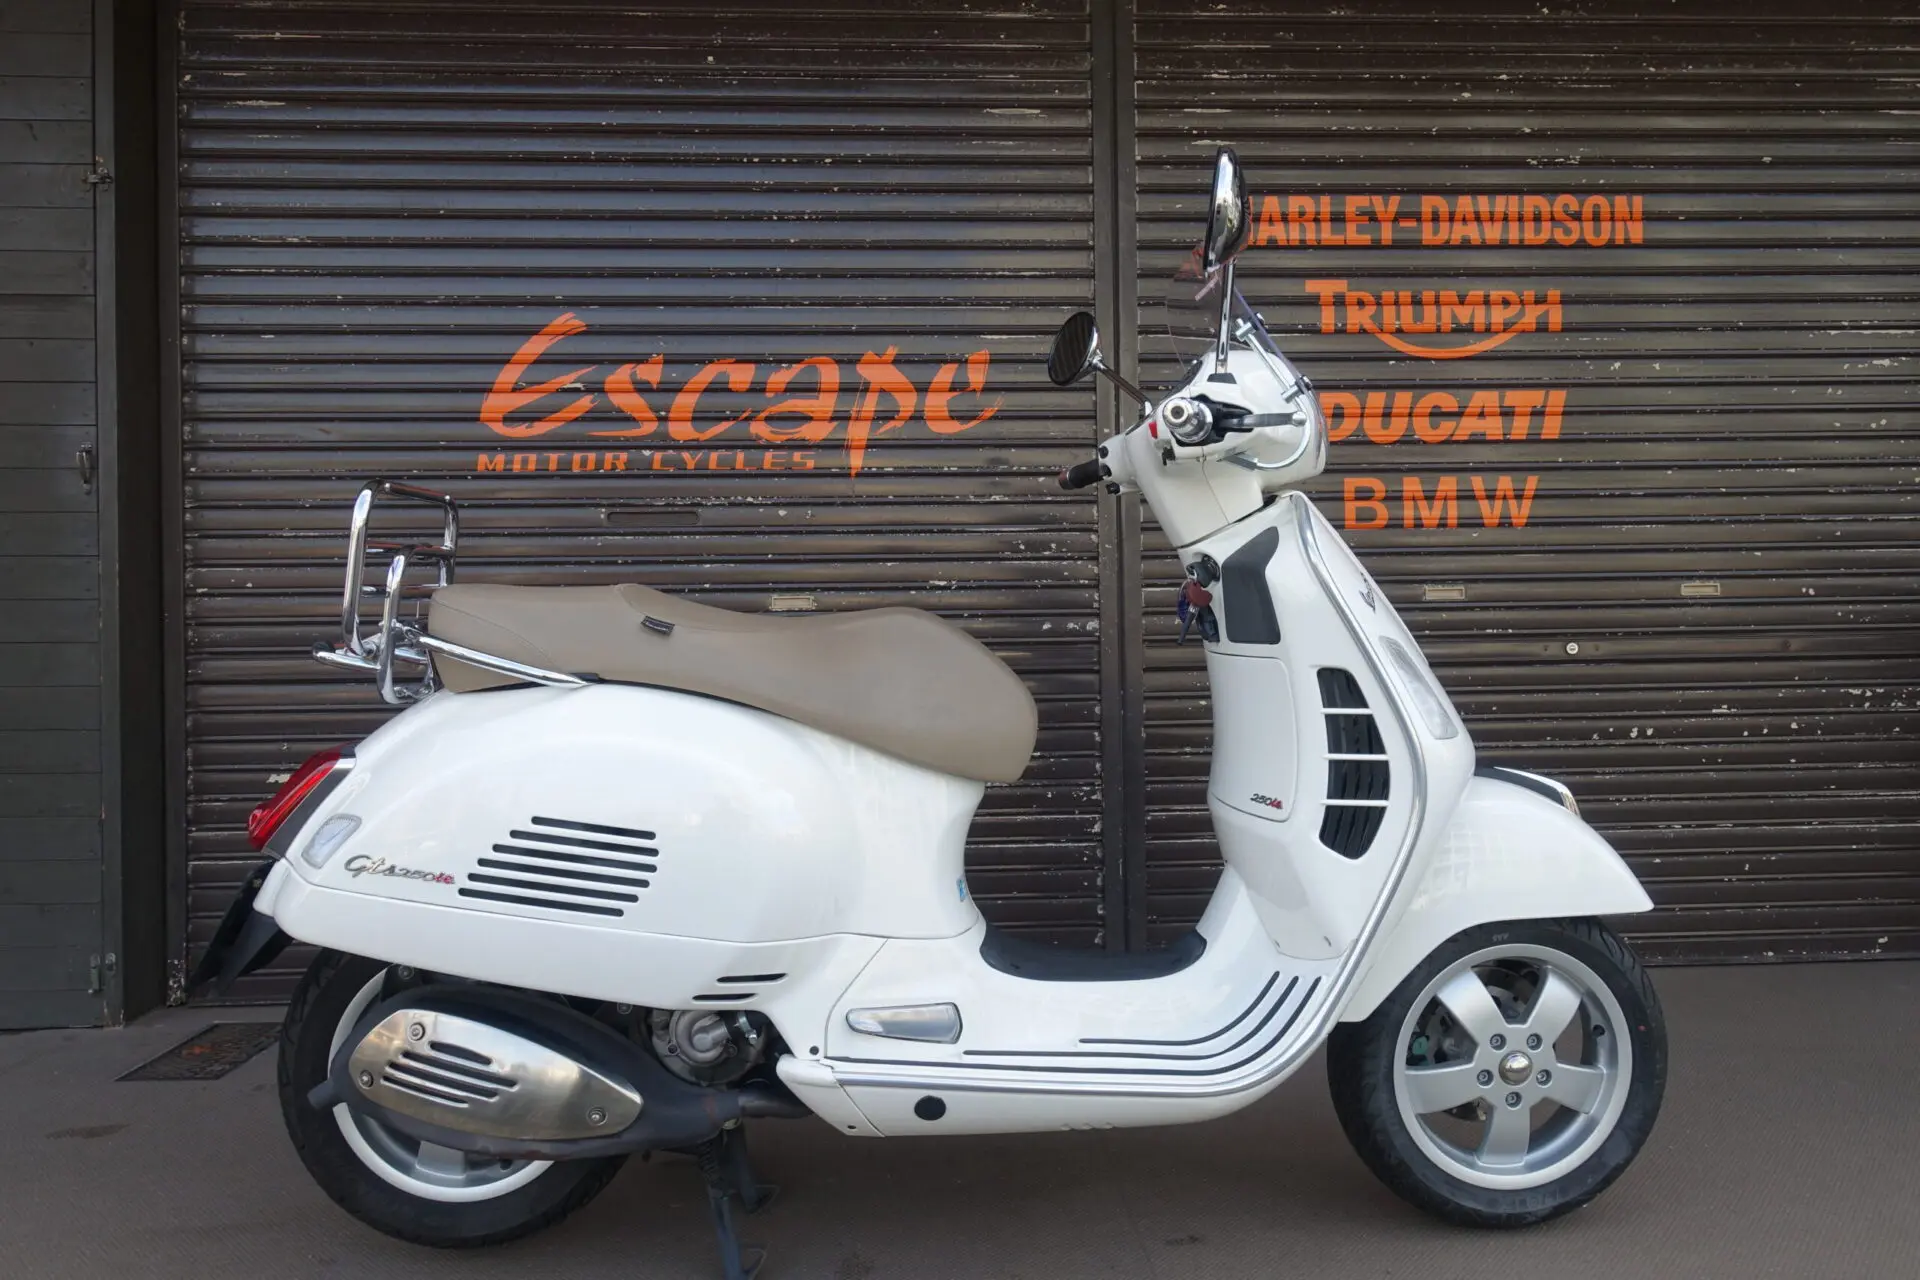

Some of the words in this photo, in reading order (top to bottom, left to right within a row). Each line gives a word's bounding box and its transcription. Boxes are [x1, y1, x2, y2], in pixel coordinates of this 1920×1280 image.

[1246, 194, 1645, 247] ARLEY-DAVIDSON
[479, 312, 1005, 478] Escape
[1318, 389, 1568, 444] DUCATI
[475, 451, 629, 473] MOTOR
[651, 451, 817, 471] CYCLES
[1343, 474, 1540, 531] BMW
